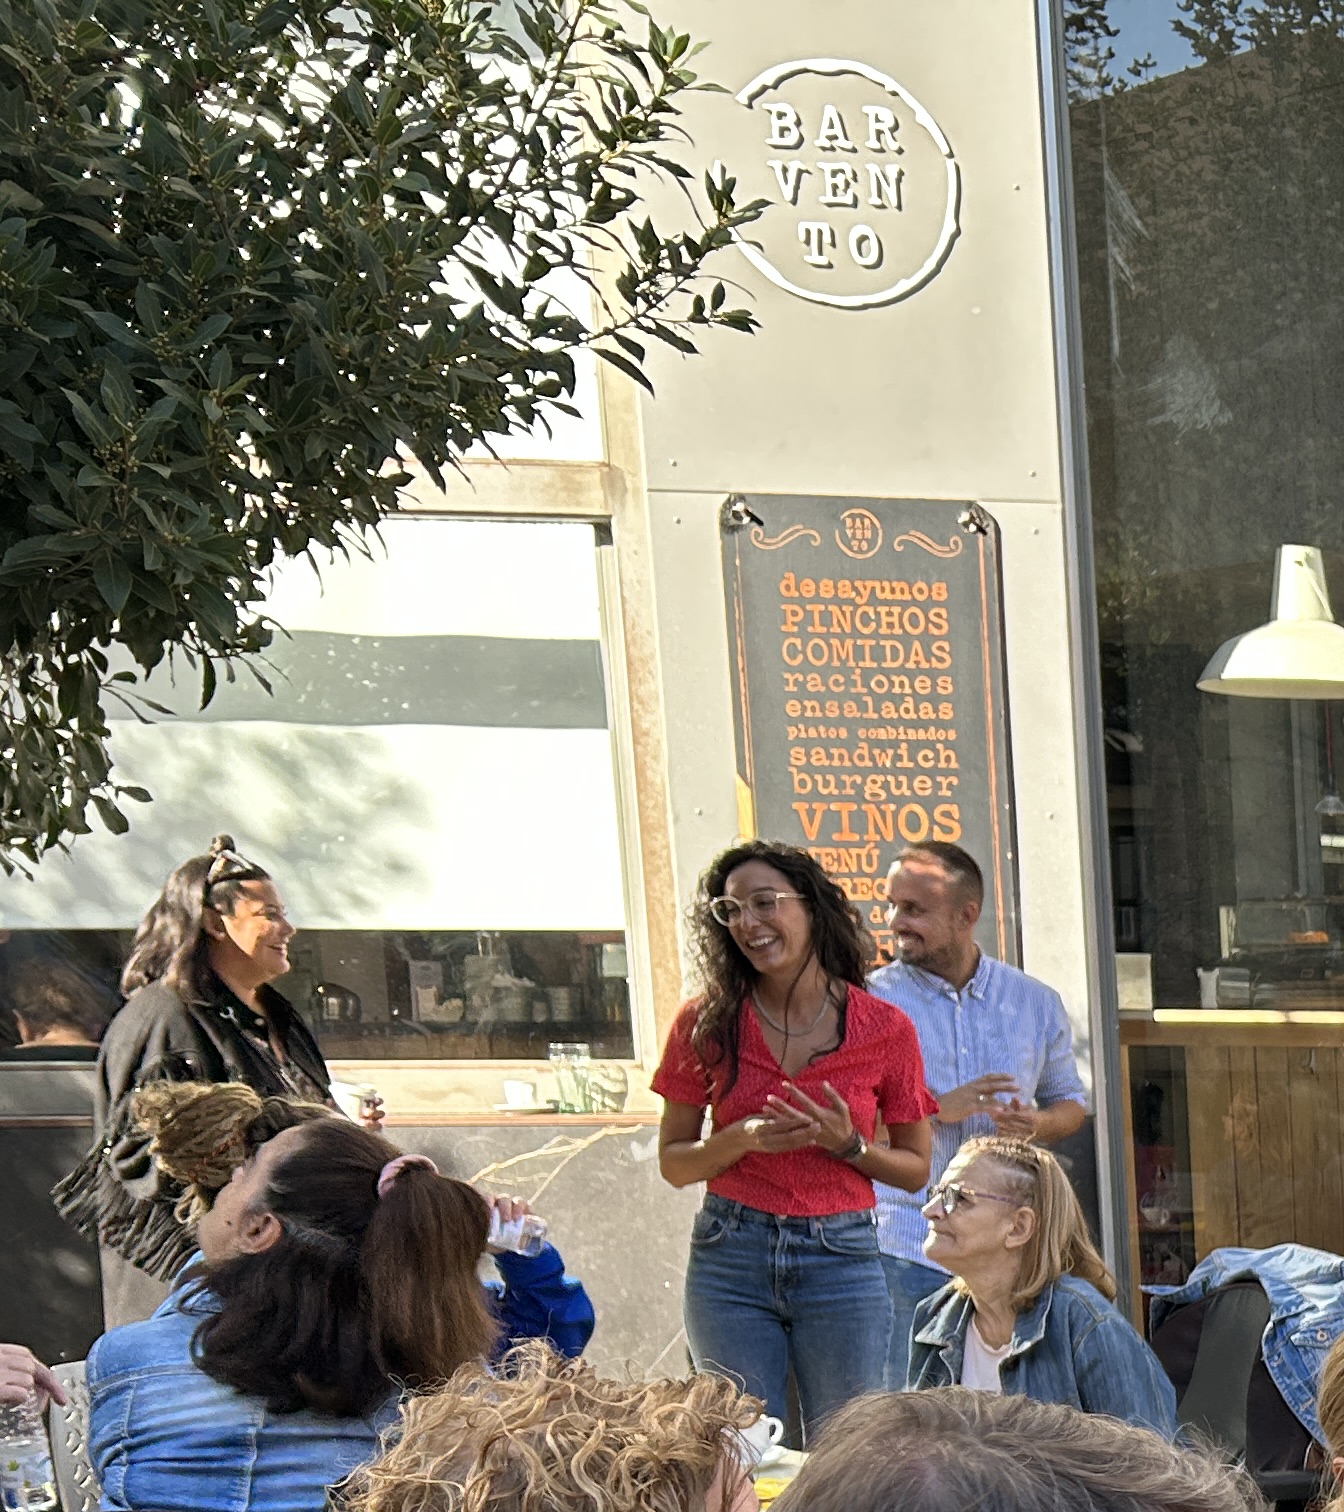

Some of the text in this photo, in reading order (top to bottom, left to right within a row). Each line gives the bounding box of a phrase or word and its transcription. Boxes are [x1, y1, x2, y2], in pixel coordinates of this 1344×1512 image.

[762, 103, 902, 152] BAR
[767, 160, 902, 209] VEN
[798, 222, 882, 267] TO
[779, 571, 949, 605] desayunos
[780, 603, 950, 636] PINCHOS
[781, 637, 952, 669] COMIDAS
[782, 668, 954, 695] raciones
[785, 695, 954, 719] ensaladas
[786, 723, 957, 742] platos combinados
[789, 741, 960, 769] sandwich
[788, 766, 960, 802] burguer
[791, 801, 962, 843] VINOS
